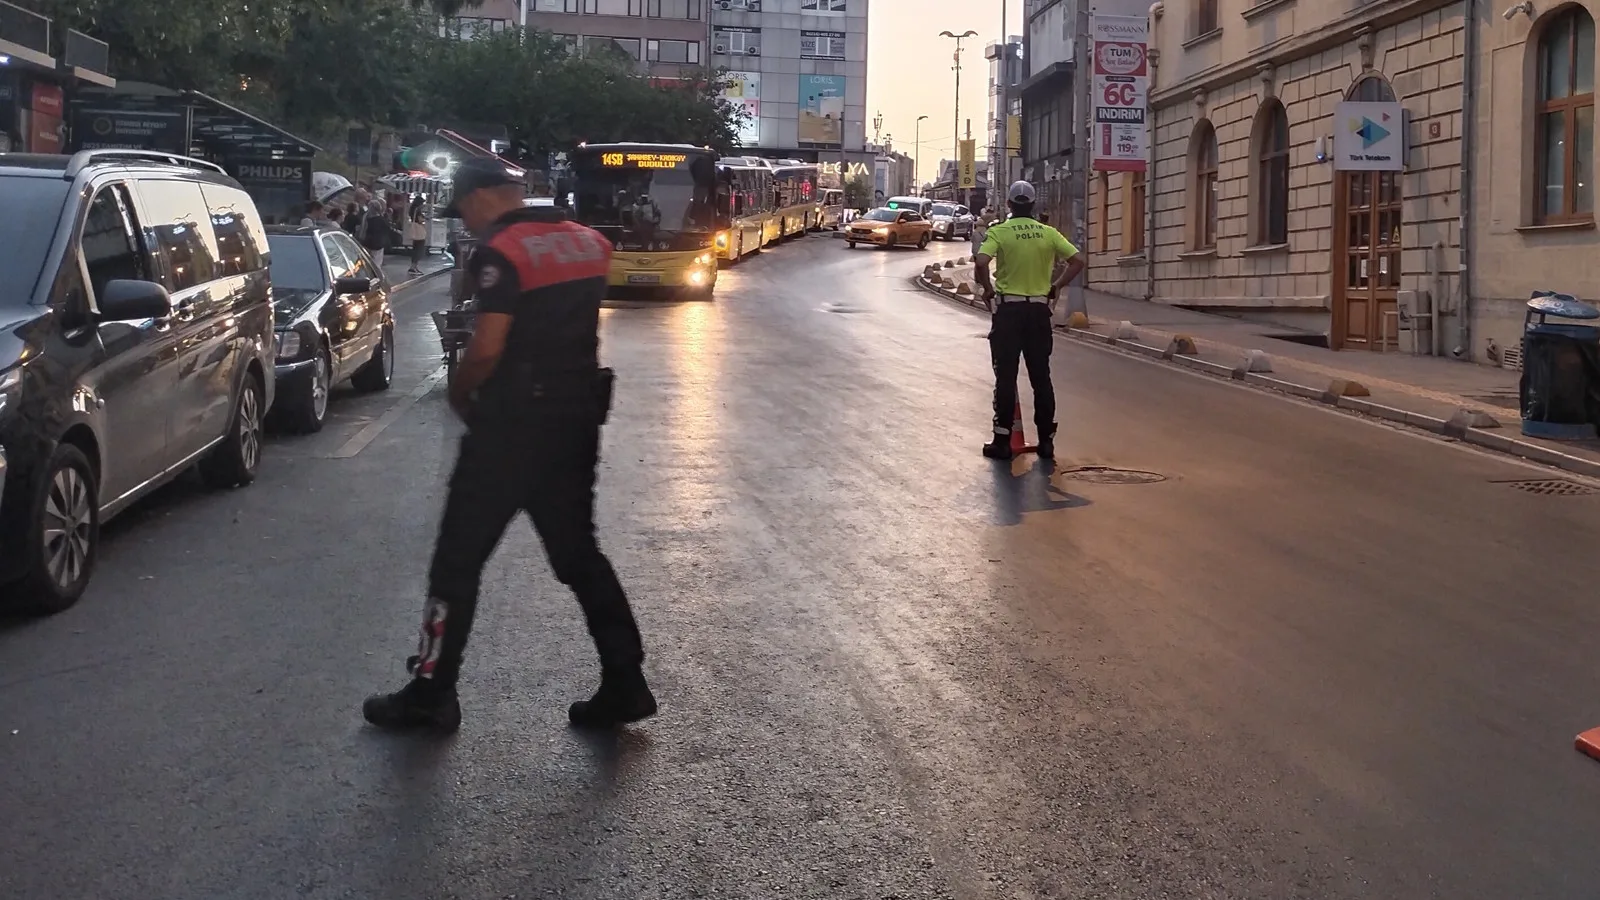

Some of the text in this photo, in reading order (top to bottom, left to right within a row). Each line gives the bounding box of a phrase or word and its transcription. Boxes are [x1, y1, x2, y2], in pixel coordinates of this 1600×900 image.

[1097, 24, 1145, 33] ROSSMANN
[638, 160, 675, 168] DUDULLU
[239, 165, 303, 179] PHILIPS
